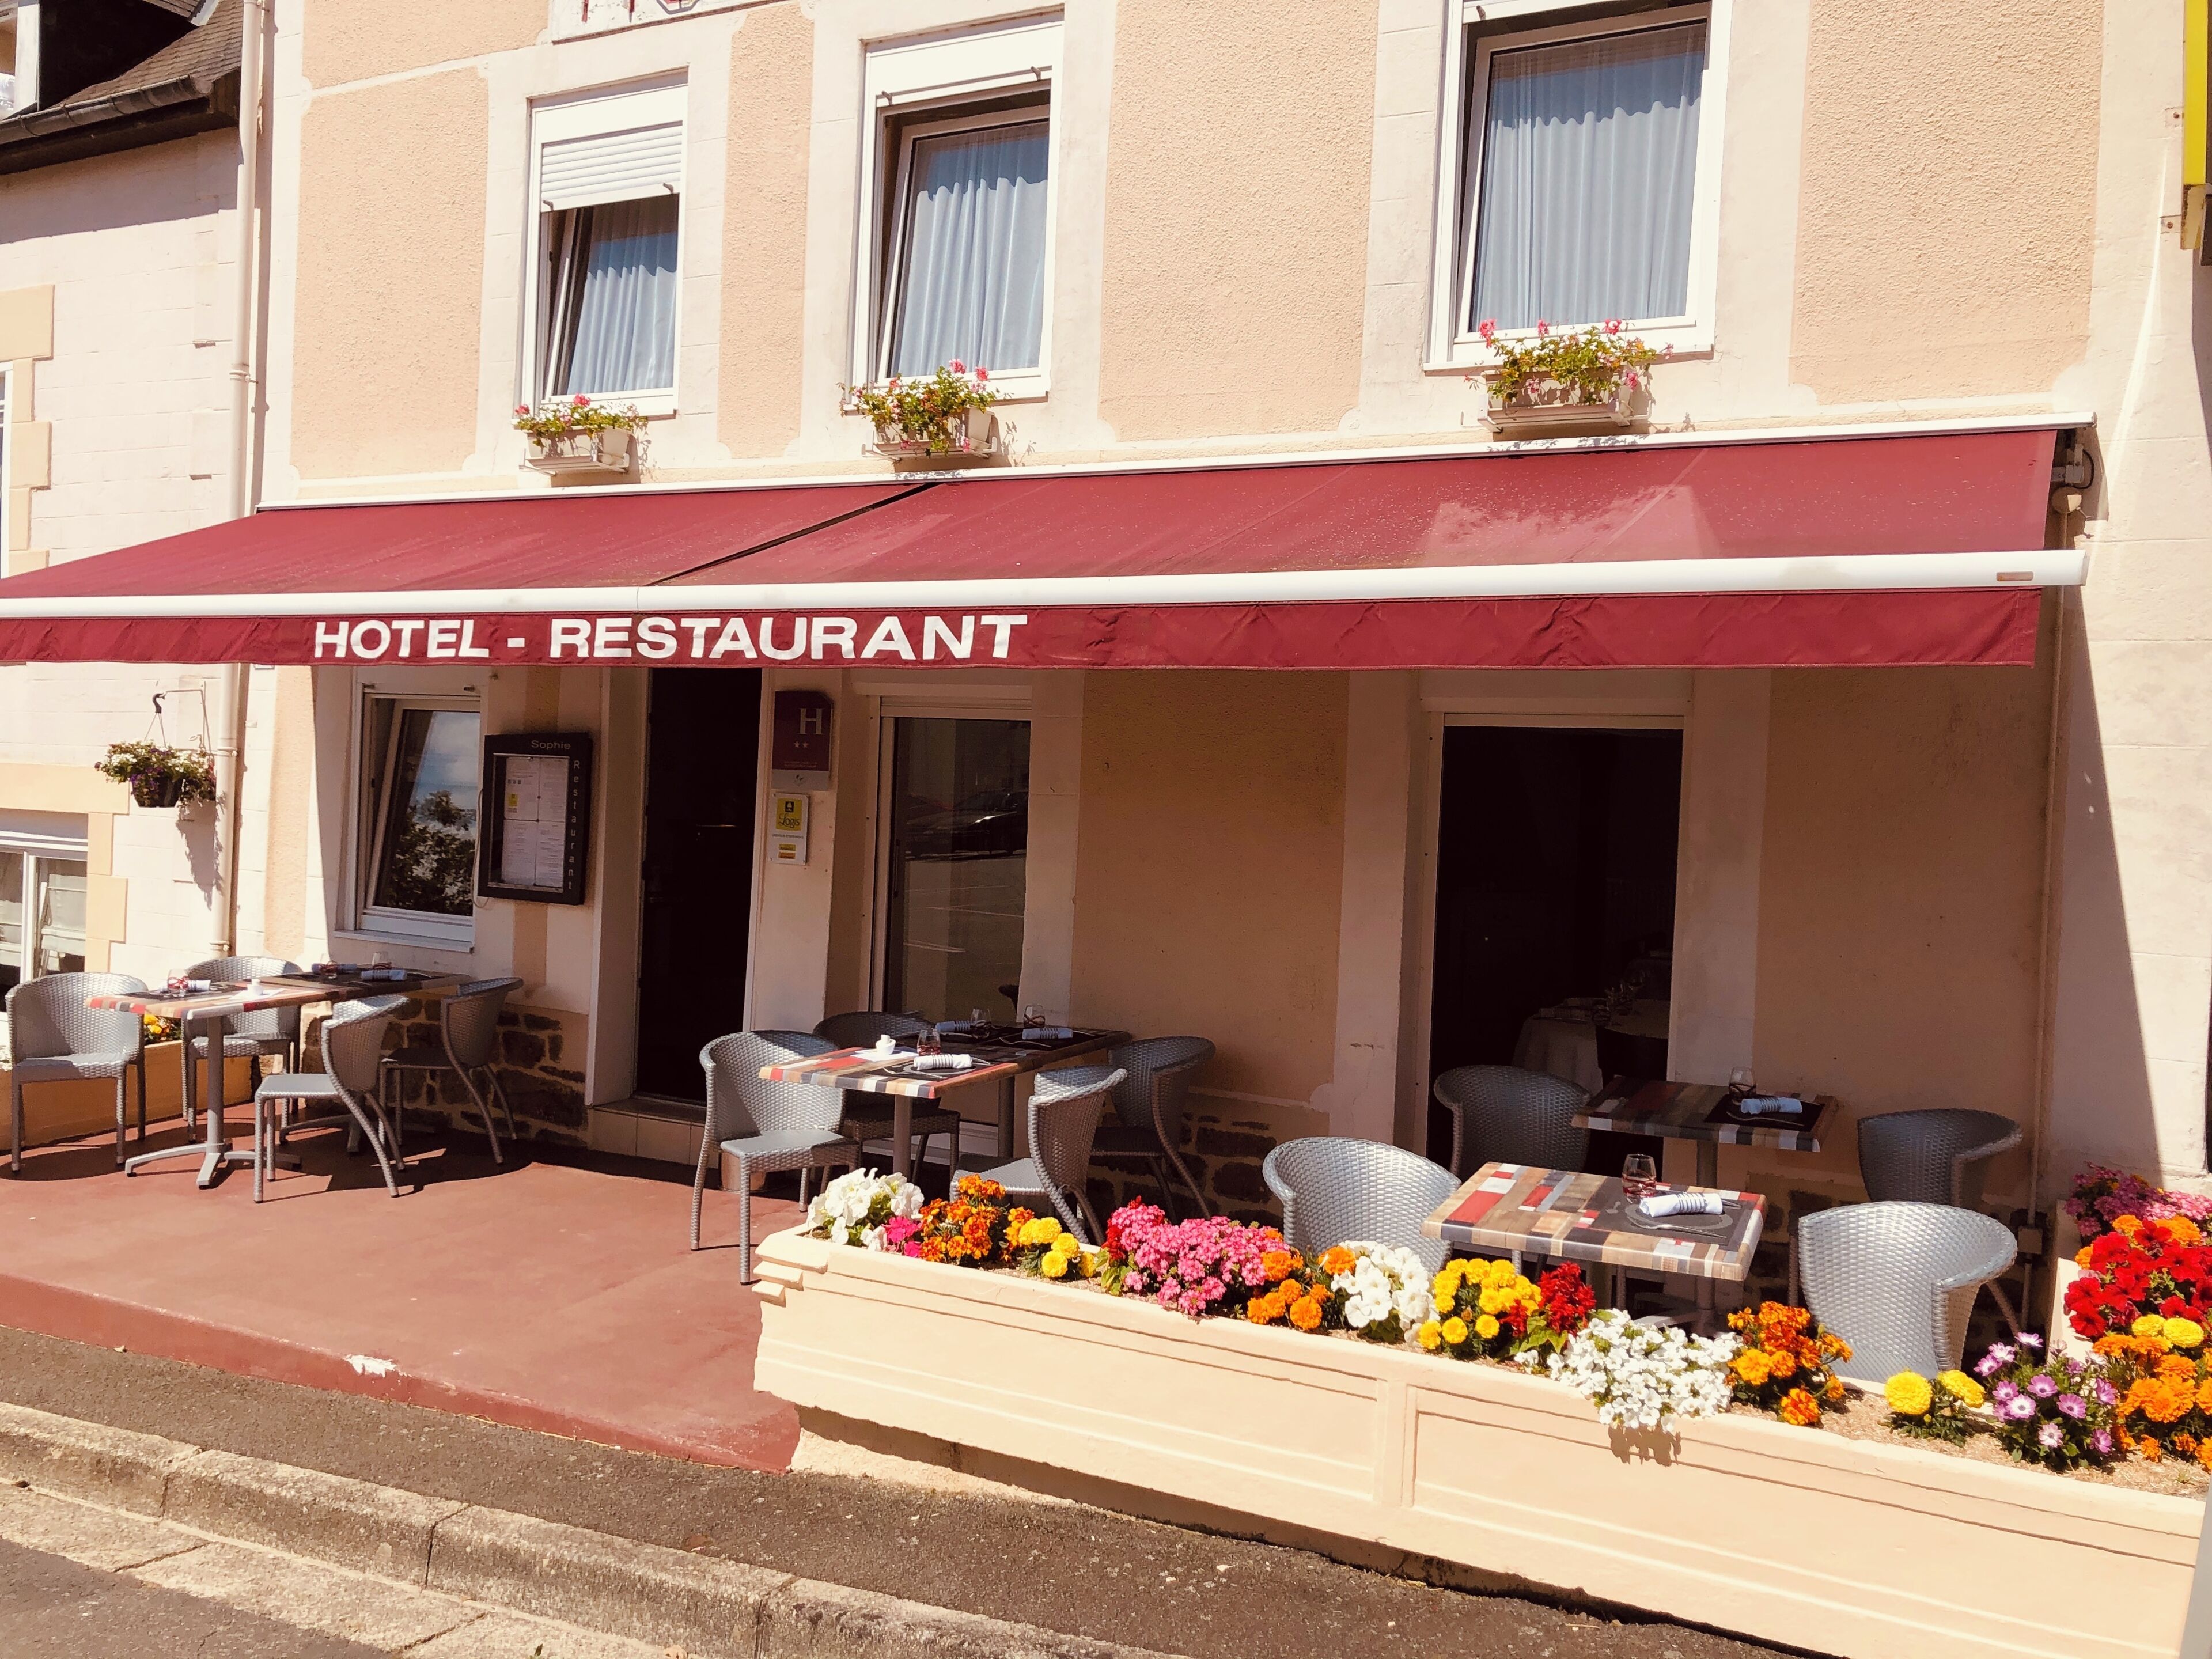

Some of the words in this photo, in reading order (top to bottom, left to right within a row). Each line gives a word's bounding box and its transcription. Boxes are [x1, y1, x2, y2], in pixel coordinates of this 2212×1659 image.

[315, 619, 489, 659] HOTEL
[507, 638, 525, 648] -
[550, 615, 1028, 661] RESTAURANT
[799, 707, 823, 734] H
[531, 740, 571, 749] Sophie
[567, 760, 580, 890] Restaurant
[779, 813, 800, 829] Logis
